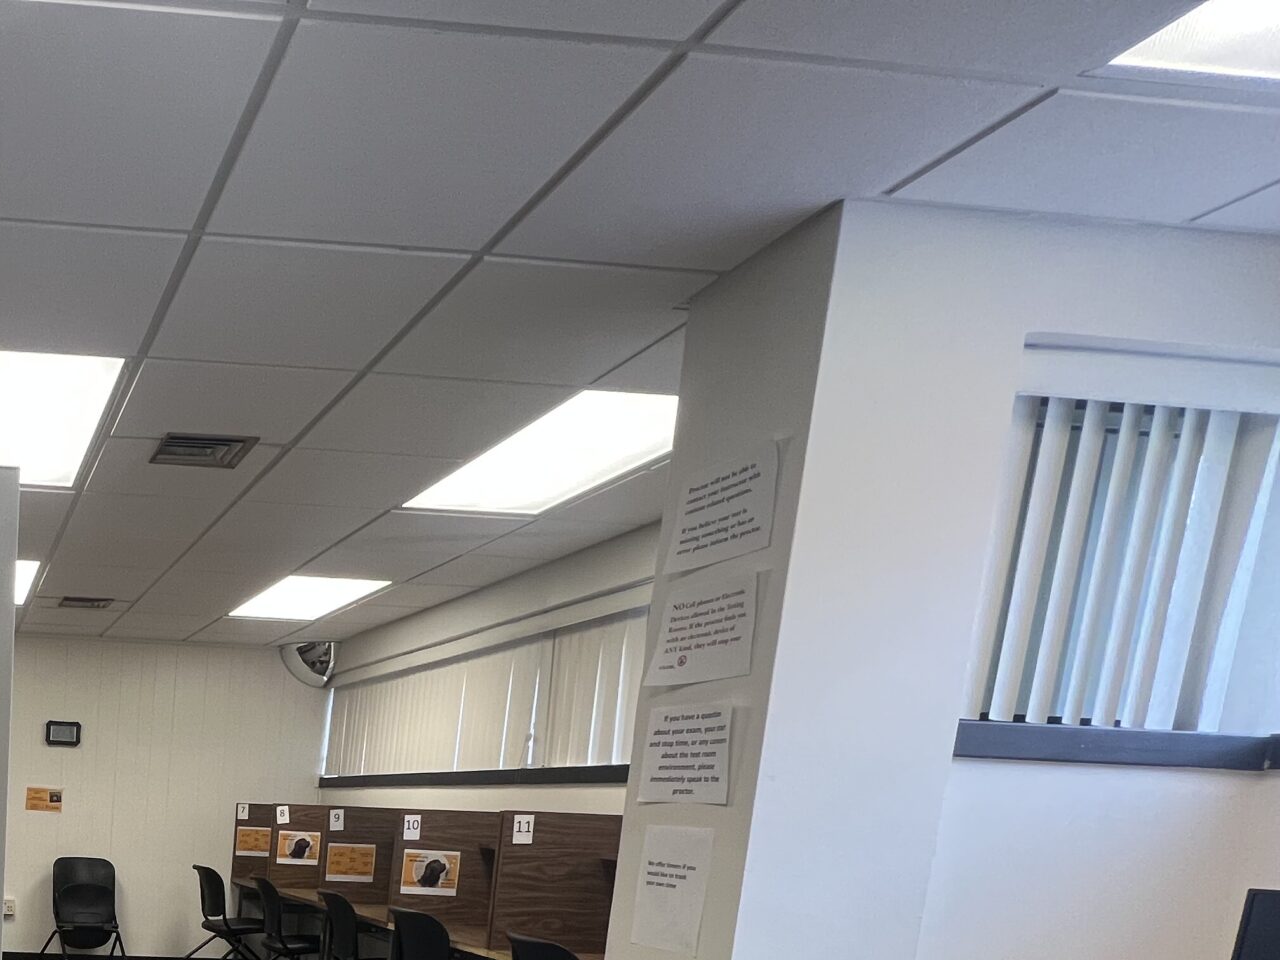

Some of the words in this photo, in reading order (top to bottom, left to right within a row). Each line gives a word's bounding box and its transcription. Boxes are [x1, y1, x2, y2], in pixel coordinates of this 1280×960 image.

[673, 603, 684, 611] NO
[685, 601, 696, 609] Cell
[665, 645, 677, 654] ANY
[241, 806, 246, 814] 7
[334, 814, 340, 822] 9
[405, 820, 419, 830] 10
[516, 821, 531, 833] 11
